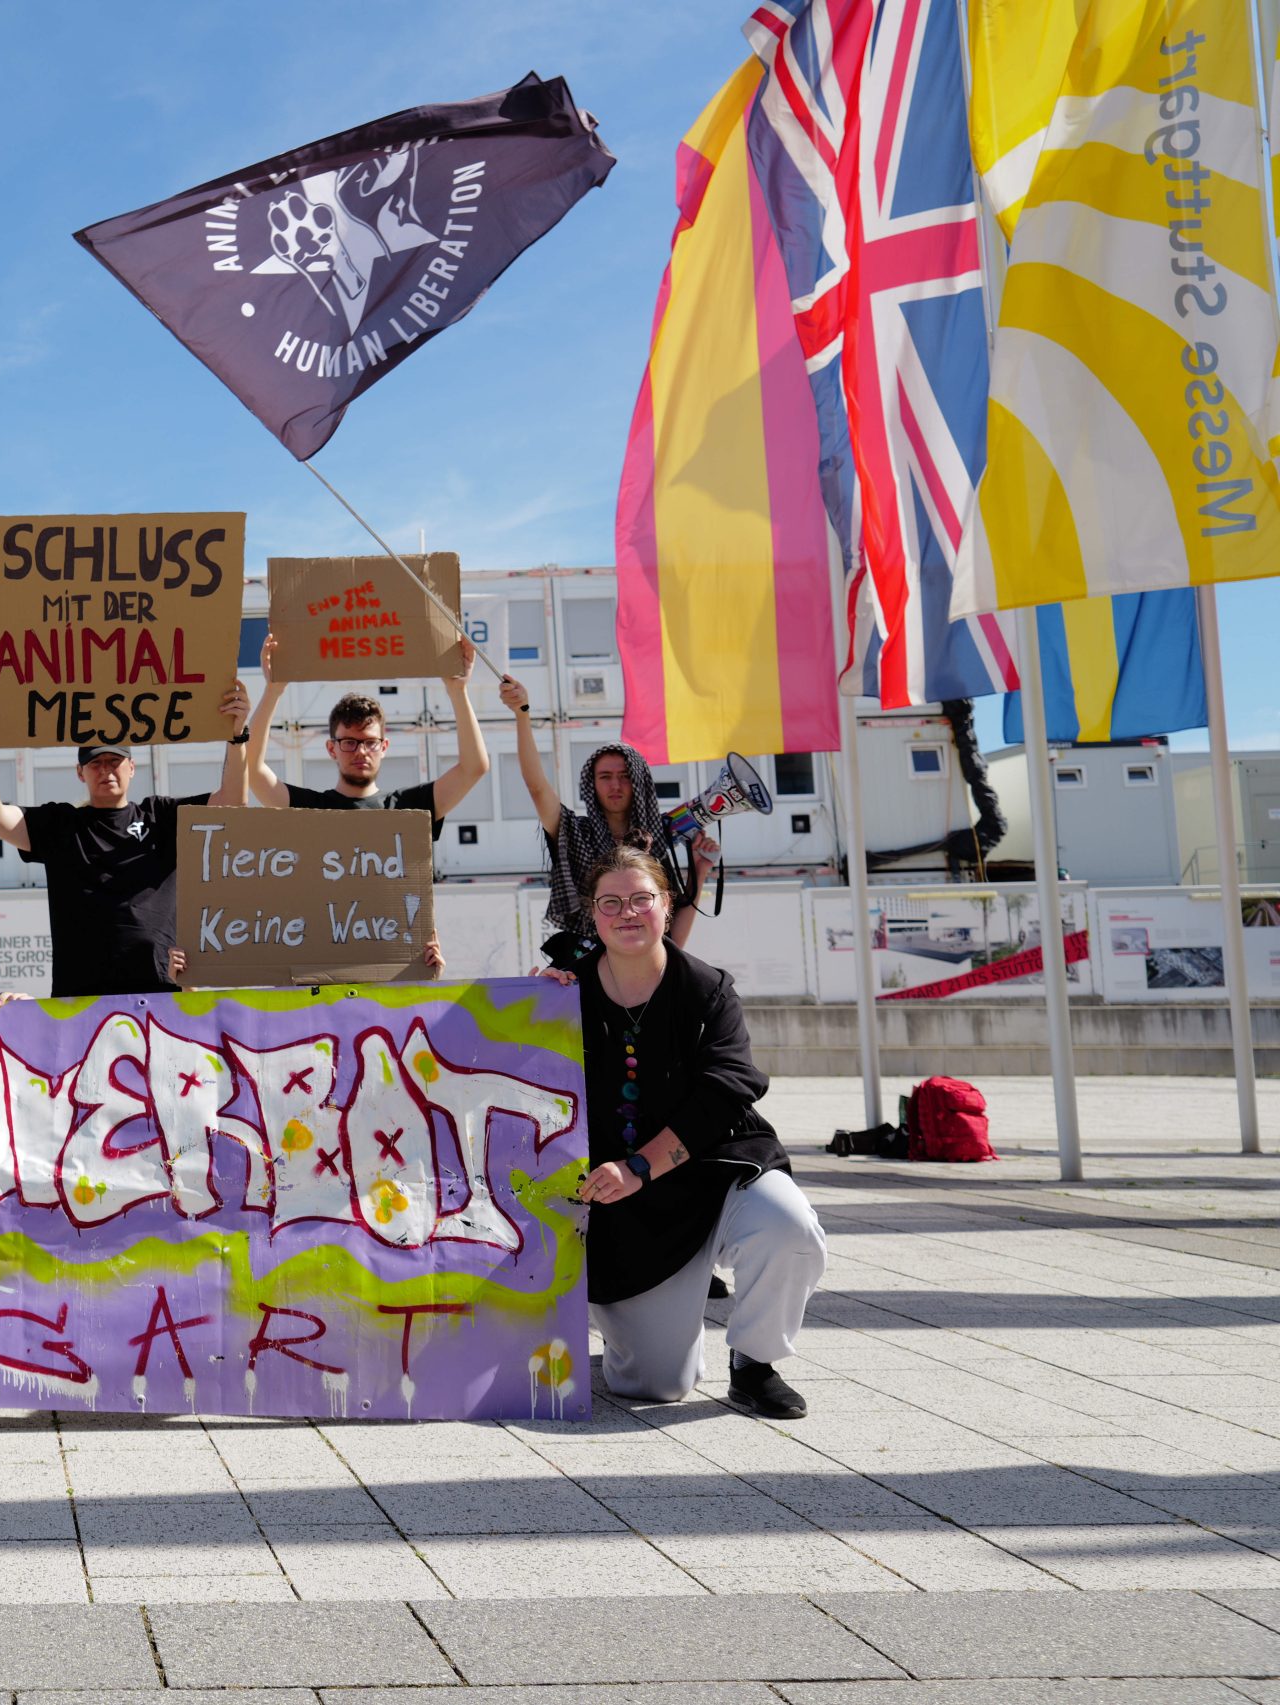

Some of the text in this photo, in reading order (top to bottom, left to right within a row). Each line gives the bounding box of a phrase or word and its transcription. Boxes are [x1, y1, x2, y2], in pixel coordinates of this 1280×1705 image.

[274, 160, 487, 378] HUMAN LIBERATION
[3, 523, 226, 597] SCHLUSS
[104, 590, 158, 623] DER
[328, 611, 401, 633] ANIMAL
[319, 634, 405, 659] MESSE
[27, 690, 192, 744] MESSE
[191, 823, 406, 882] Tiere sind
[34, 935, 51, 948] TE
[200, 893, 421, 952] Keine Ware!
[16, 950, 53, 963] GROS
